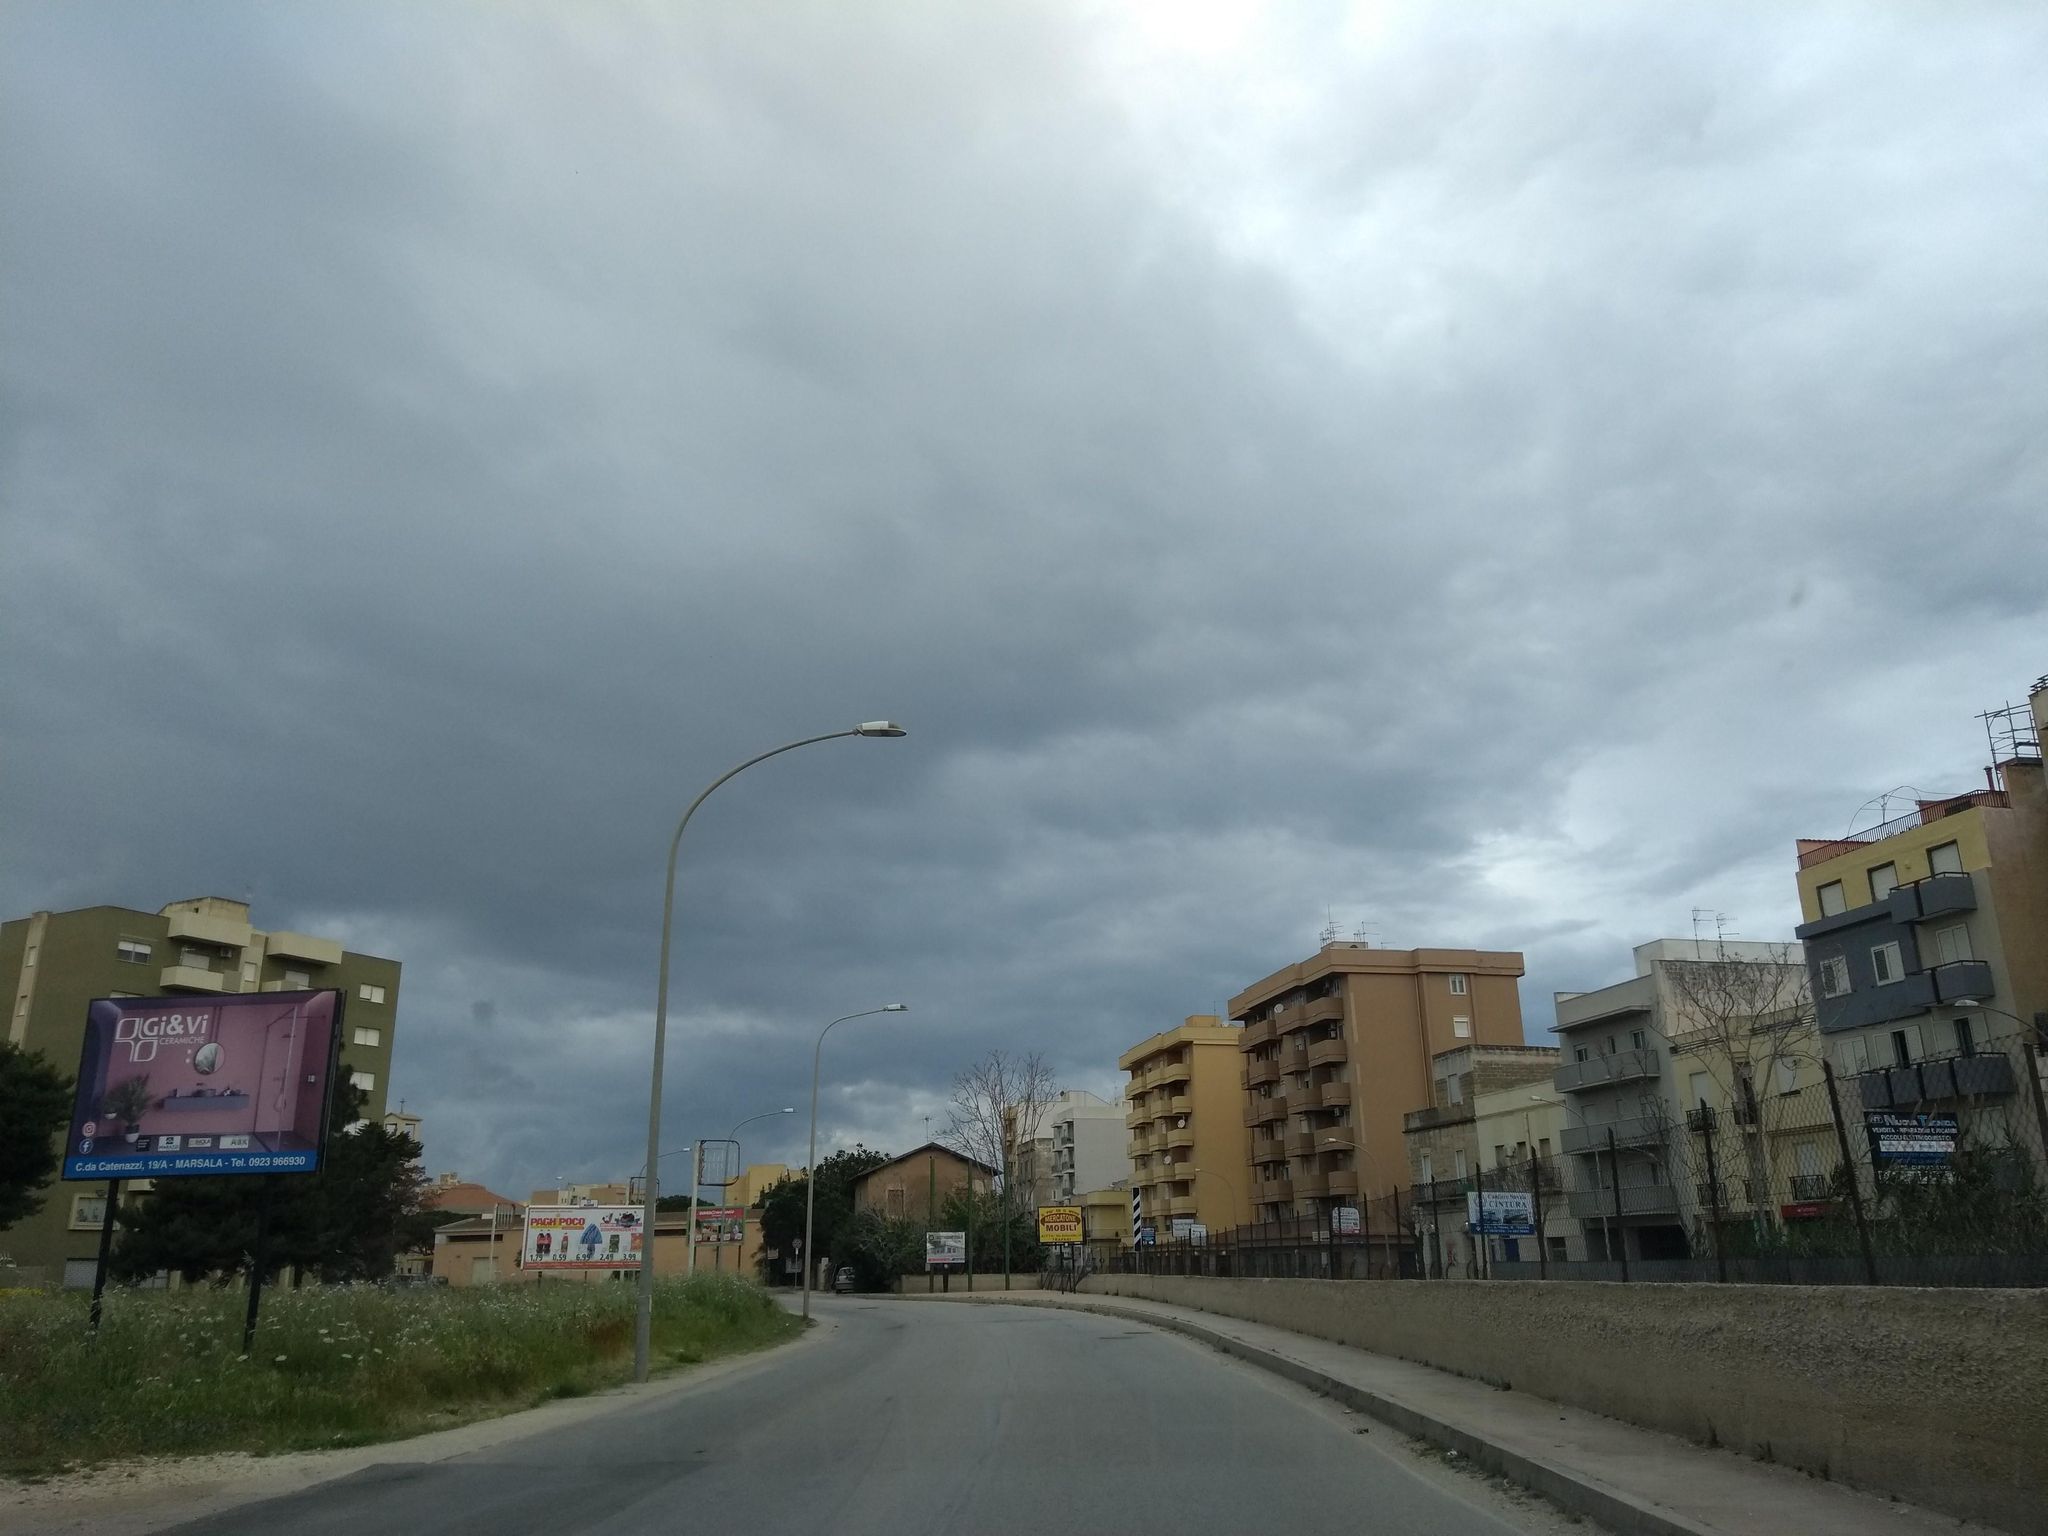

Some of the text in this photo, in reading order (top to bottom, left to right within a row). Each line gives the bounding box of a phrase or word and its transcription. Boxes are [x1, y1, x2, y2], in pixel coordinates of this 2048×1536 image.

[144, 1014, 209, 1036] Gi&Vi
[159, 1036, 205, 1045] CERAMICHE
[75, 1162, 96, 1171] C.da
[98, 1160, 145, 1171] Catenazzi,
[148, 1159, 168, 1169] 19/A
[175, 1158, 223, 1169] MARSALA
[231, 1157, 247, 1167] Tel.
[249, 1156, 271, 1167] 0923
[272, 1156, 306, 1166] 966930
[1489, 1200, 1528, 1208] CINTURA
[1045, 1224, 1077, 1232] MOBILI
